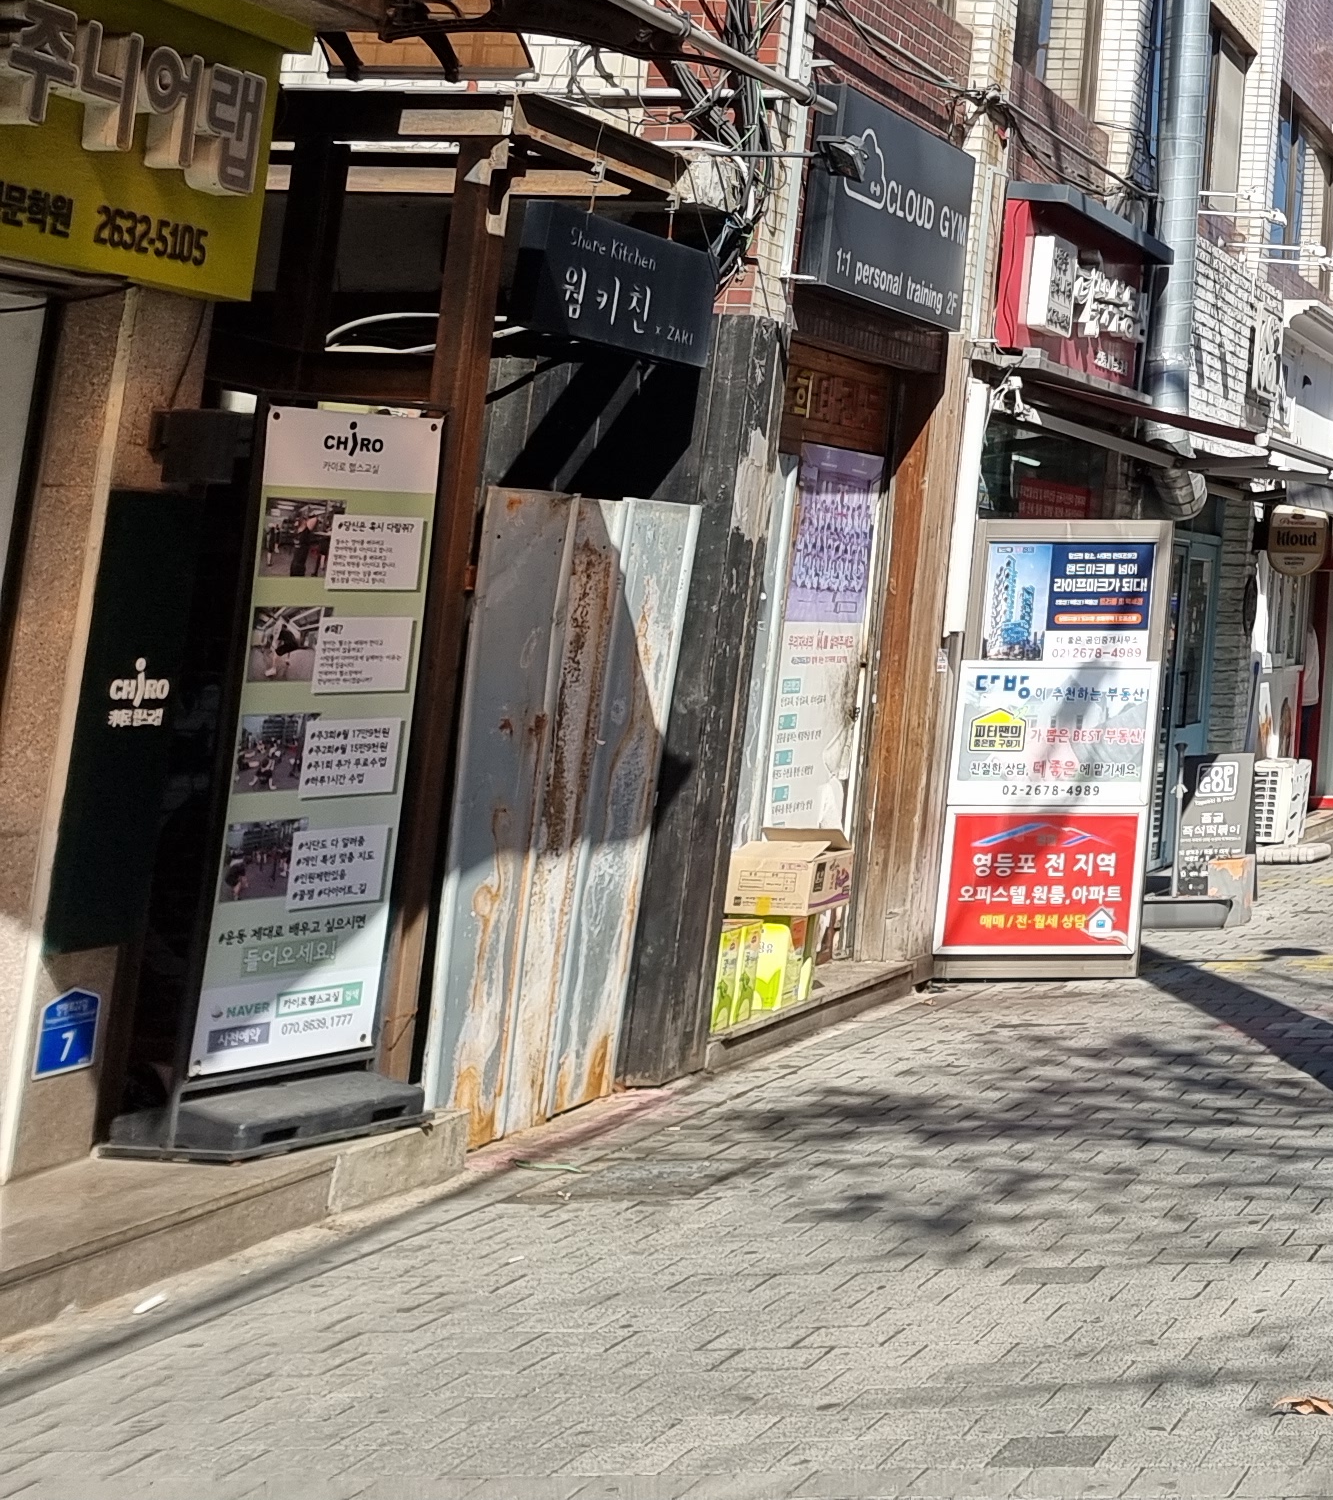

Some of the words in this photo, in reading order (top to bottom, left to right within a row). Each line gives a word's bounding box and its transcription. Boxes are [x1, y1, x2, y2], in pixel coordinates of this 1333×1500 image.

[886, 180, 935, 230] CLOUD
[939, 205, 967, 247] GYM
[93, 204, 209, 267] 2632-5105
[570, 226, 606, 255] Share
[610, 238, 656, 271] Kitchen
[836, 247, 852, 277] 1:1
[854, 260, 903, 297] personal
[907, 275, 944, 316] training
[947, 291, 959, 316] 2F
[1072, 729, 1102, 742] BEST
[970, 762, 1003, 776] 친절한
[1049, 760, 1076, 778] 좋은
[1002, 784, 1100, 796] 02-2678-4989
[972, 852, 1037, 877] 영등포
[1044, 852, 1065, 877] 전
[1072, 852, 1117, 877] 지역
[1061, 914, 1087, 930] 상담
[242, 939, 337, 973] 들어오세요!
[226, 1001, 271, 1019] NAVER
[61, 1029, 77, 1062] 7
